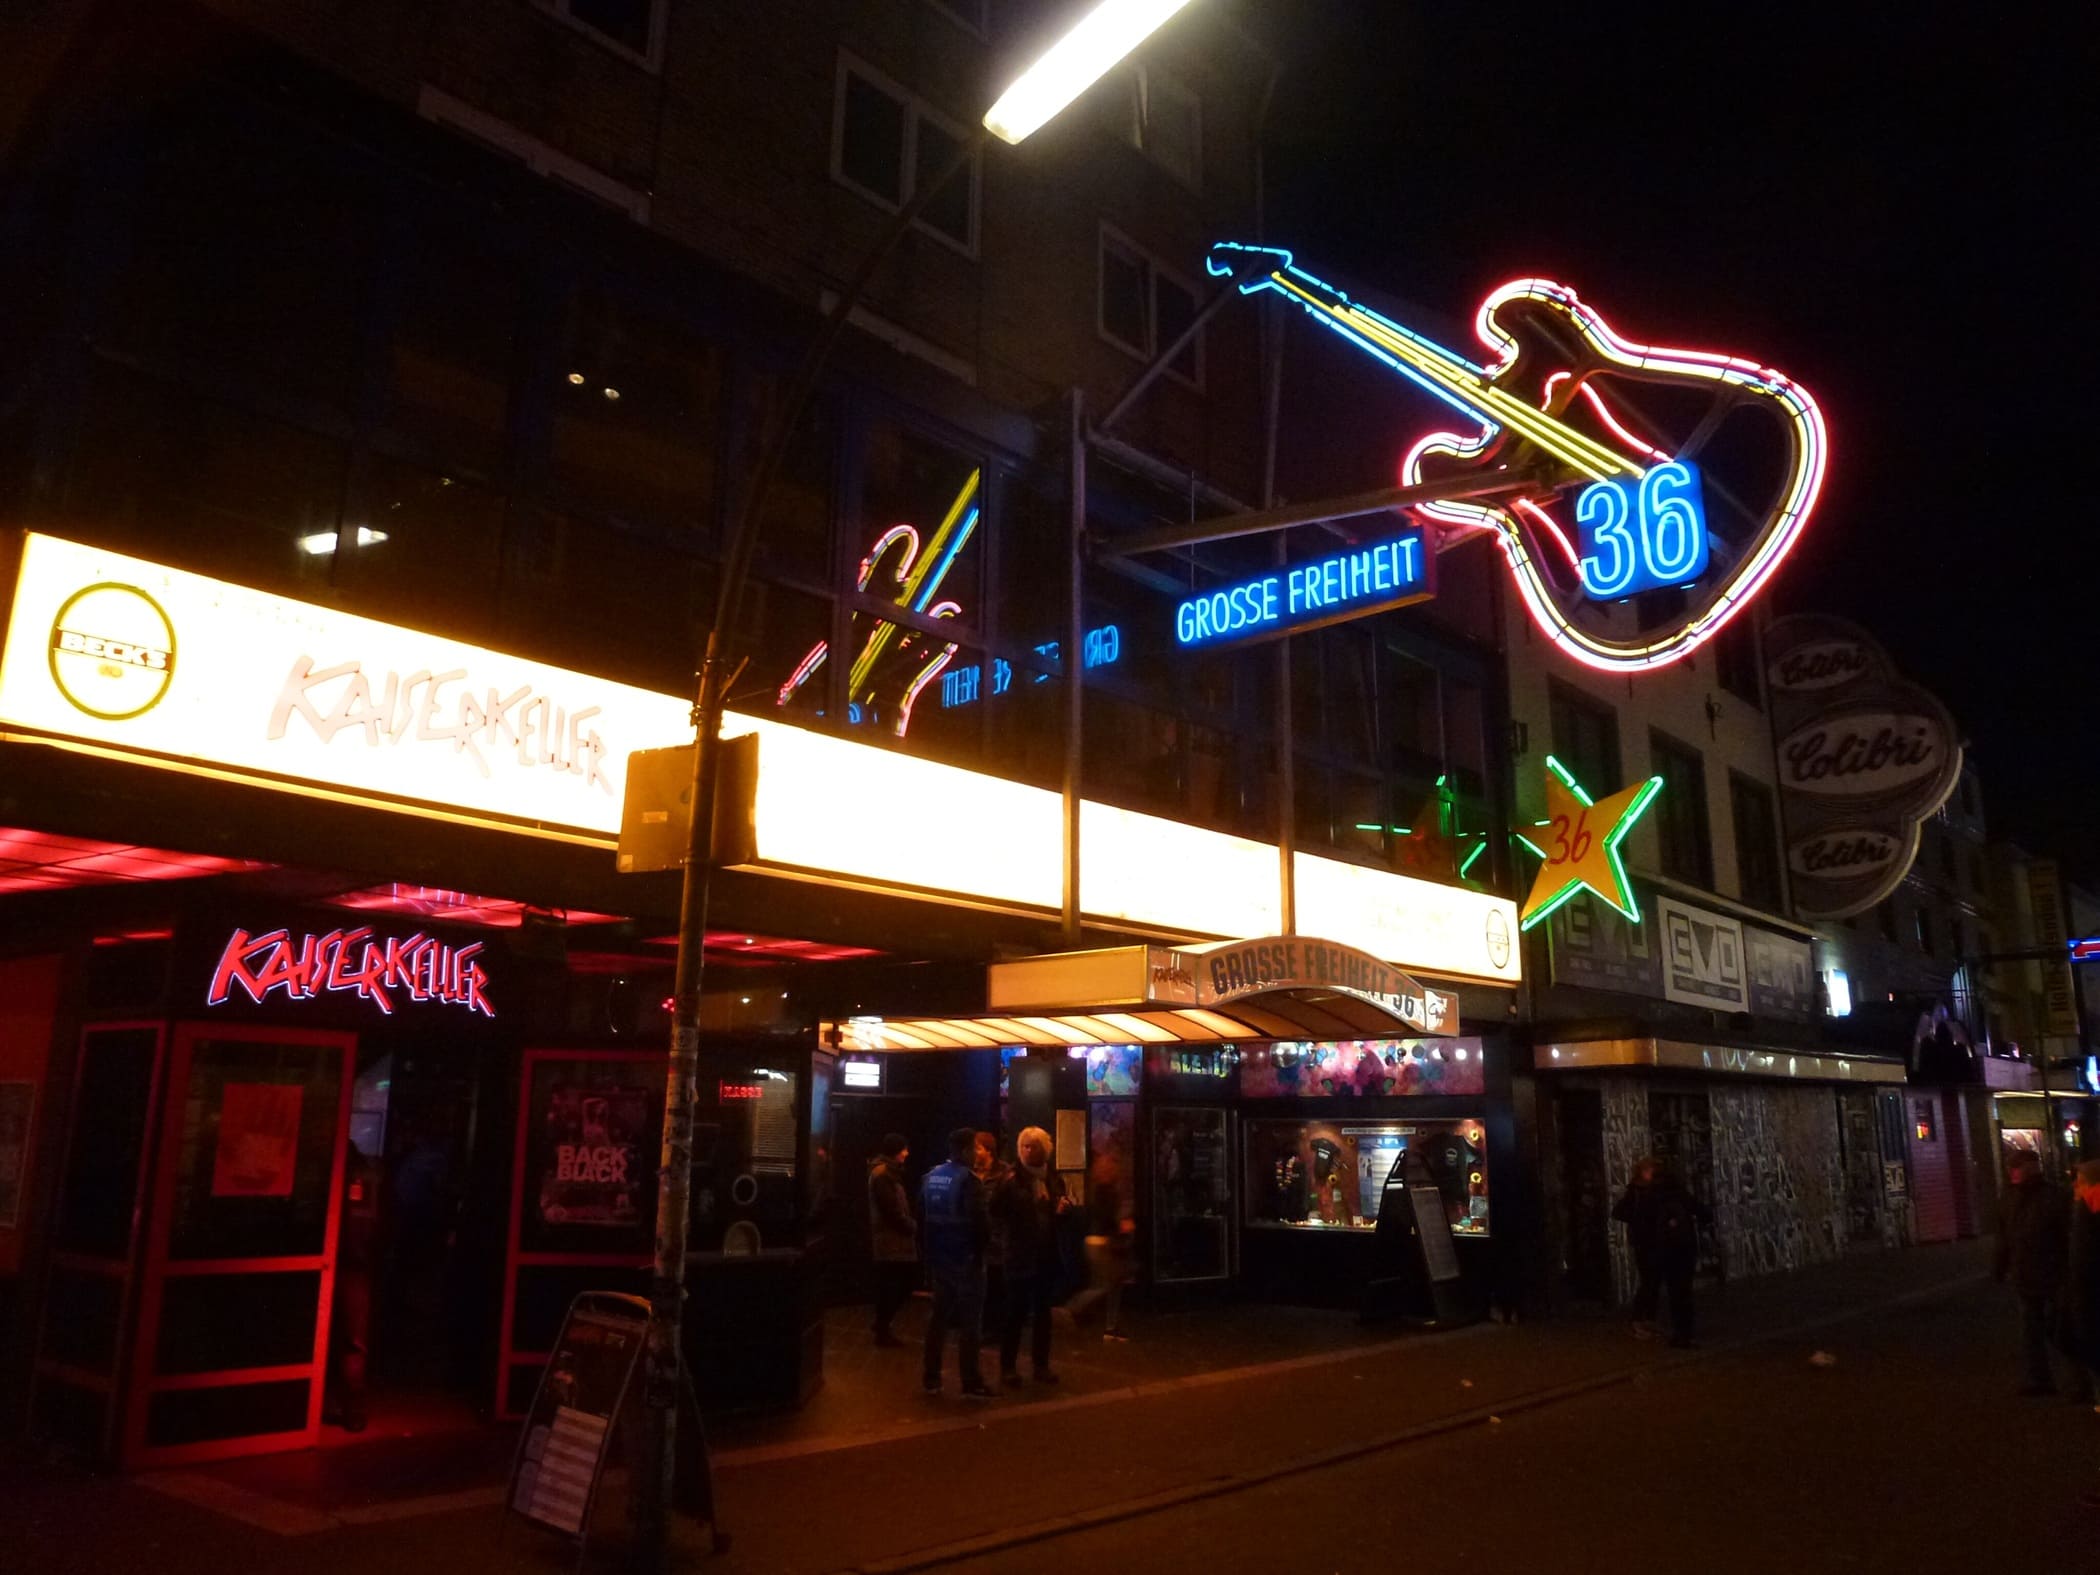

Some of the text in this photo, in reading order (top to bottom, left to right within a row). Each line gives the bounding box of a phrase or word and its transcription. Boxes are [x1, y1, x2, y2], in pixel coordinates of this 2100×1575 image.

[1576, 462, 1700, 595] 36
[1177, 537, 1418, 643] GROSSE FREIHEIT
[267, 655, 613, 796] KAISERKELLER
[1788, 727, 1933, 782] Colibri
[1548, 810, 1592, 865] 36
[1802, 837, 1892, 872] Colibri
[208, 927, 495, 1017] KAISERKELLER
[1210, 943, 1296, 995] GROSSE
[1303, 943, 1390, 1002] FREIHEIT
[1667, 911, 1741, 986] EVO
[557, 1145, 628, 1167] BACK
[557, 1164, 627, 1183] BLACK
